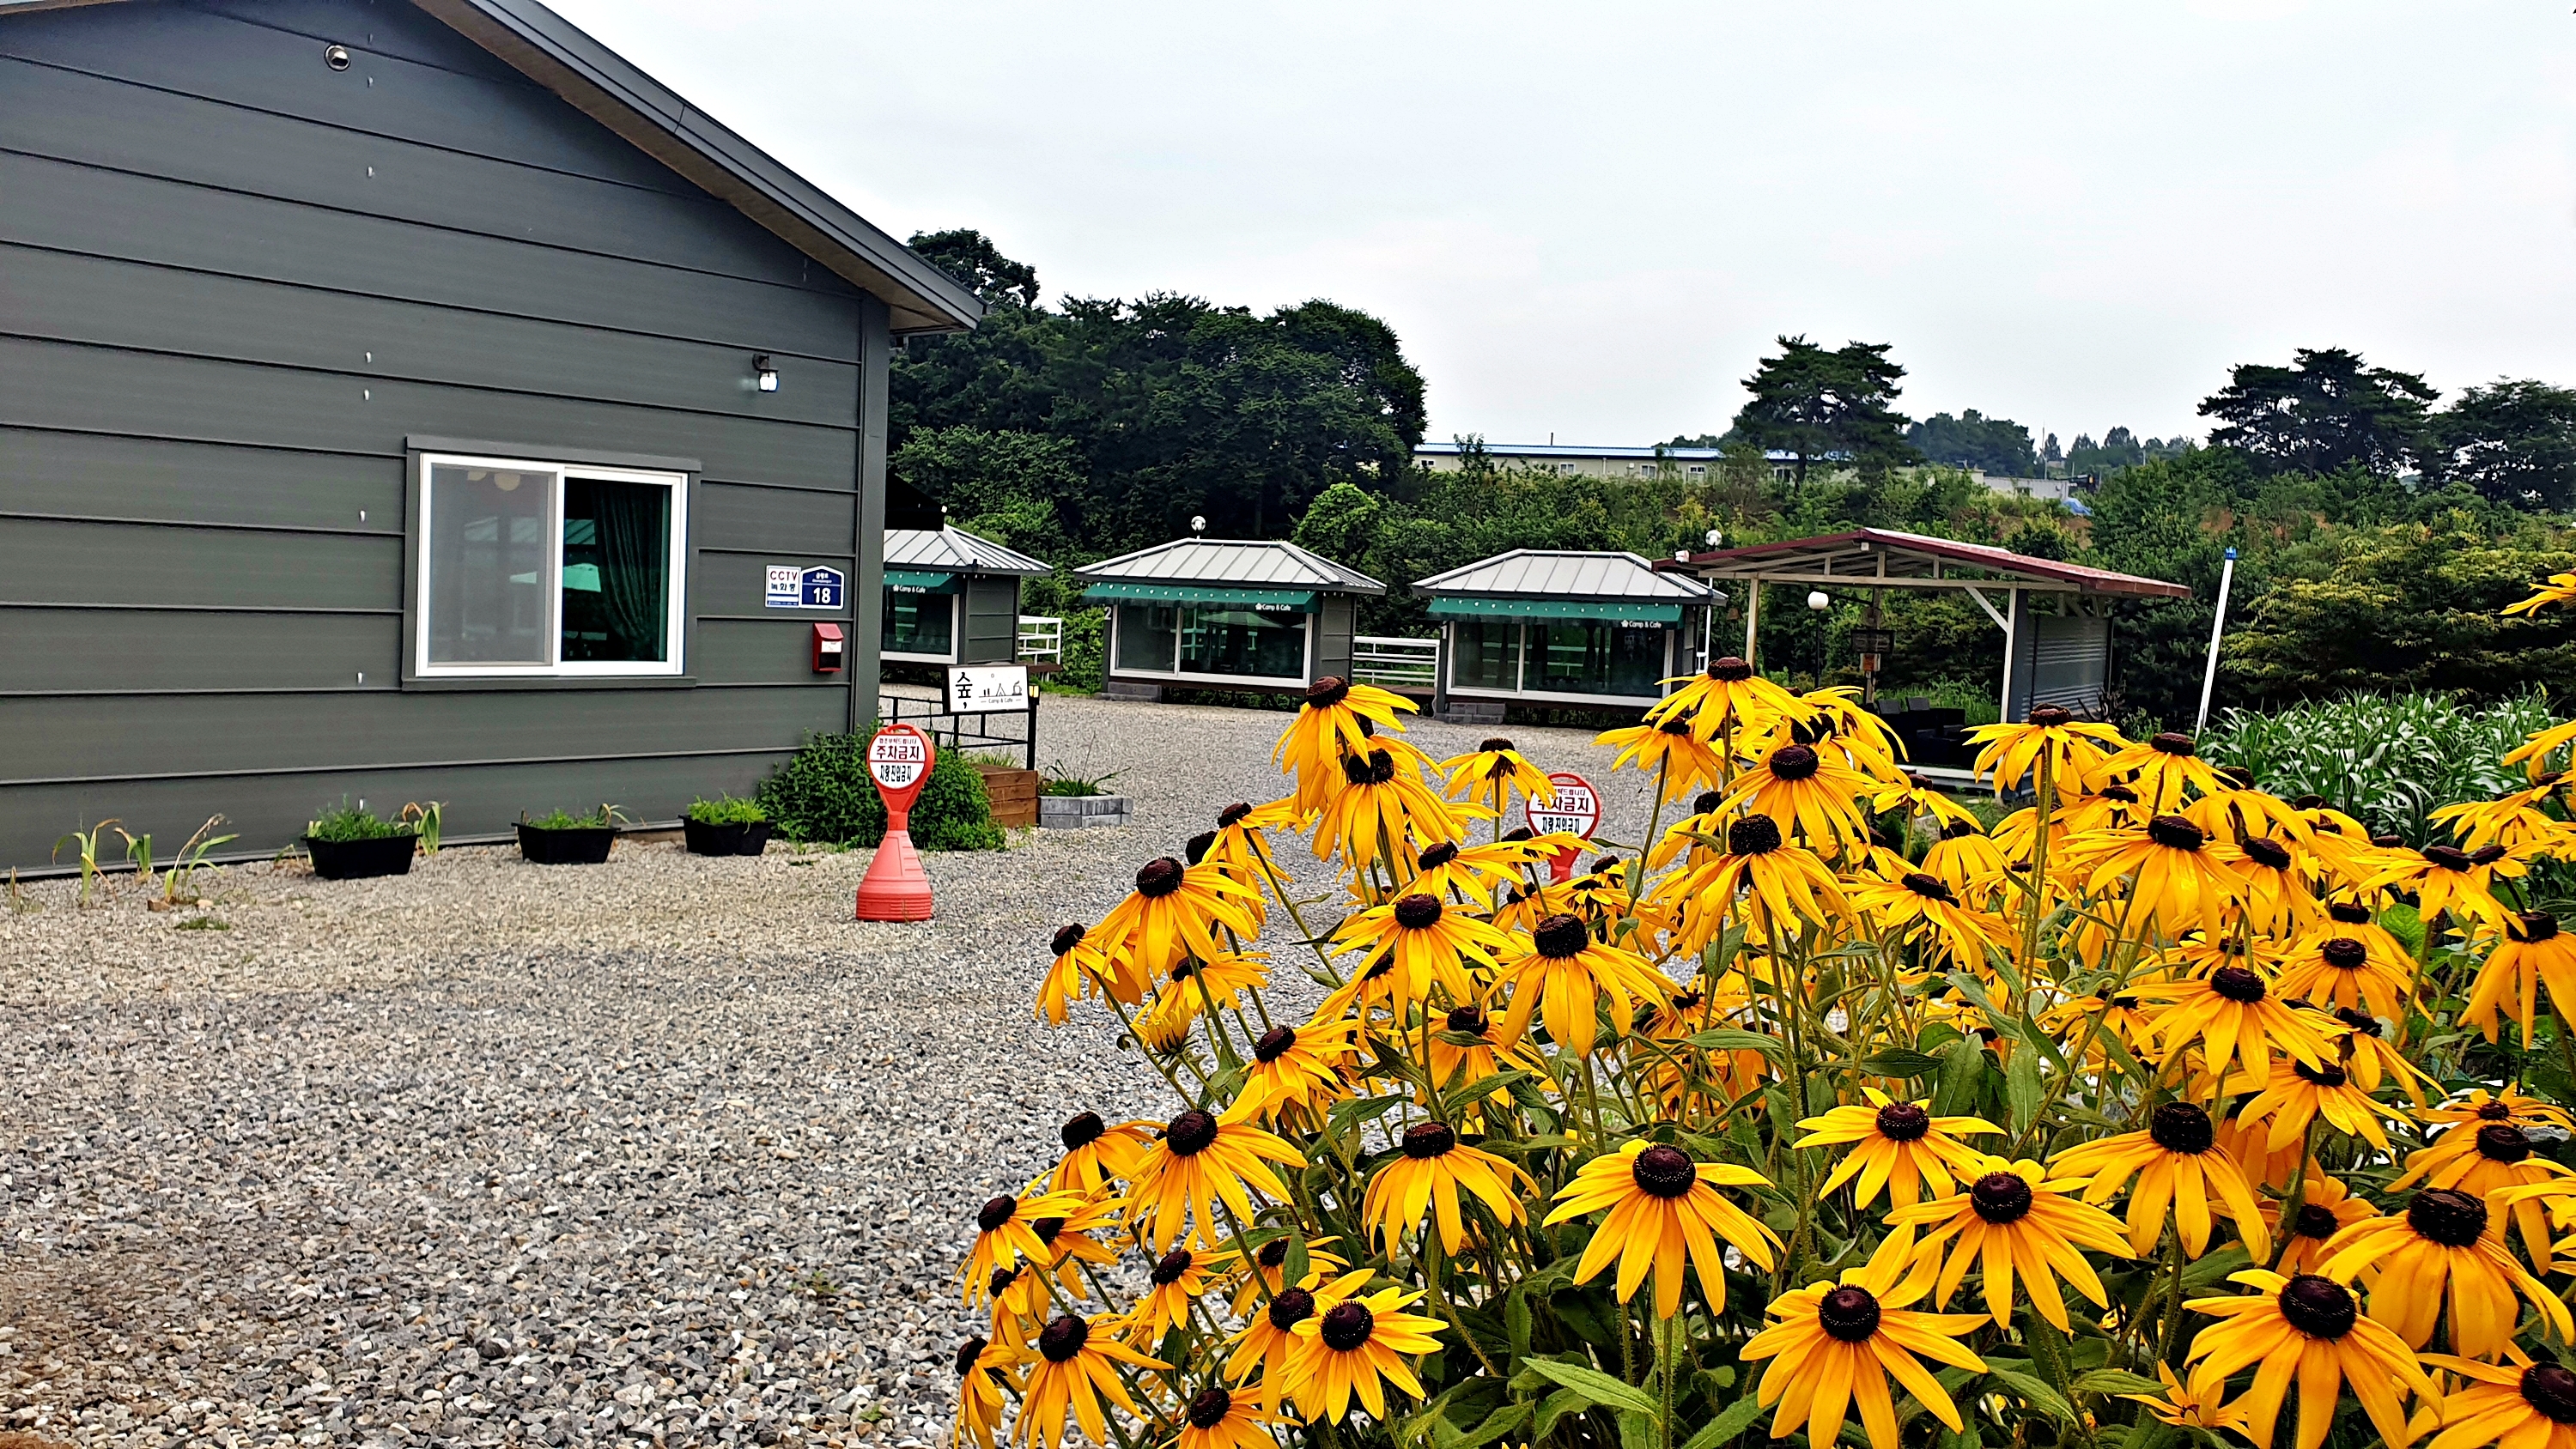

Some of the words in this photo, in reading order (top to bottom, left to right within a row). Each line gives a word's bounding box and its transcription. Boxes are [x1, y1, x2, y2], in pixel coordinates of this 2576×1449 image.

[769, 571, 798, 581] CCTV
[813, 587, 830, 603] 18
[899, 585, 911, 593] Camp
[1104, 606, 1112, 620] 2
[877, 745, 919, 760] 주차금지
